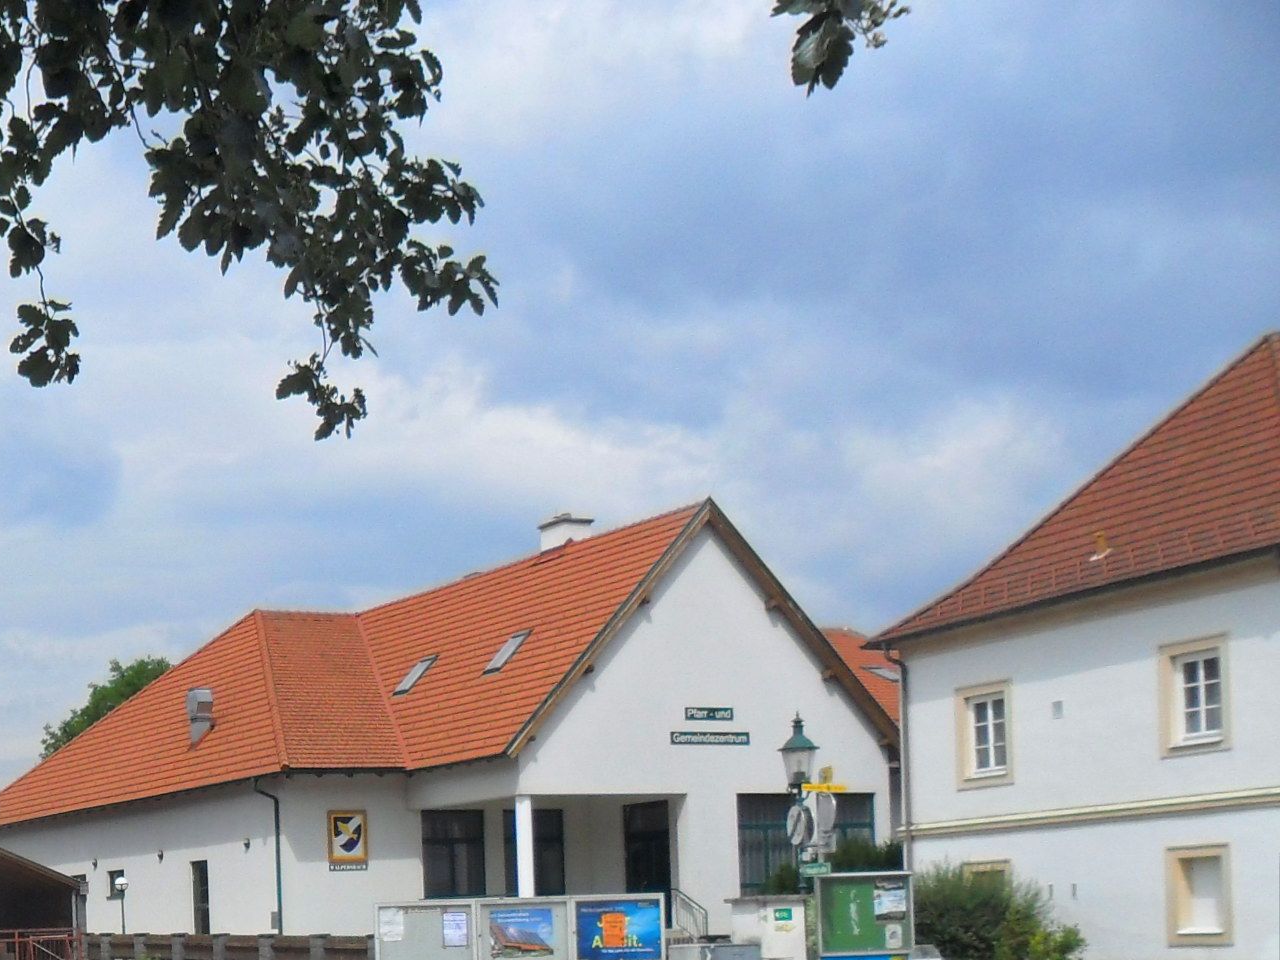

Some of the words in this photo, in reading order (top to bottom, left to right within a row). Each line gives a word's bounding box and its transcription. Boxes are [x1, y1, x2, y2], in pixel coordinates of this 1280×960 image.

[686, 708, 708, 719] Pfarr
[715, 709, 732, 719] und
[672, 733, 748, 744] Gemeindezentrum
